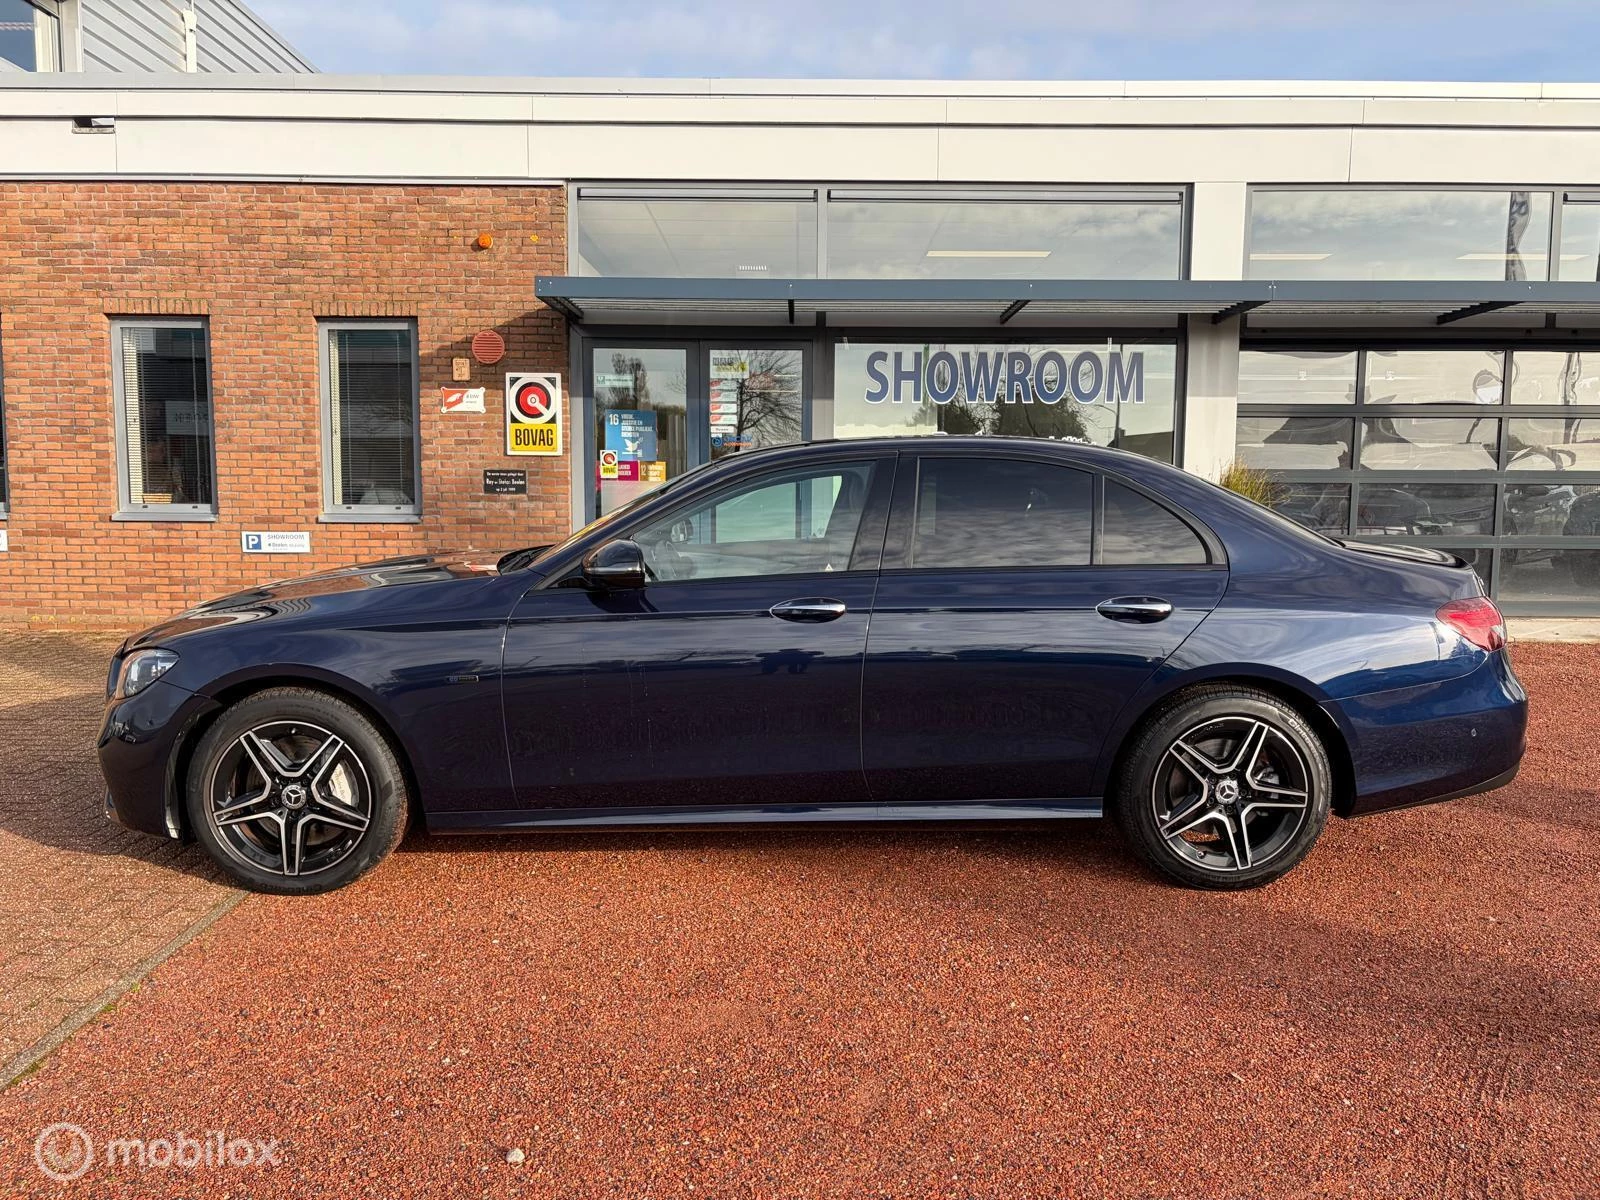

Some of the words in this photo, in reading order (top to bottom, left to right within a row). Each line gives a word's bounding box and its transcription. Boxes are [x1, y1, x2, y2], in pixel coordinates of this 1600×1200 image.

[864, 350, 1145, 404] SHOWROOM
[609, 414, 619, 425] 16
[515, 429, 554, 447] BOVAG
